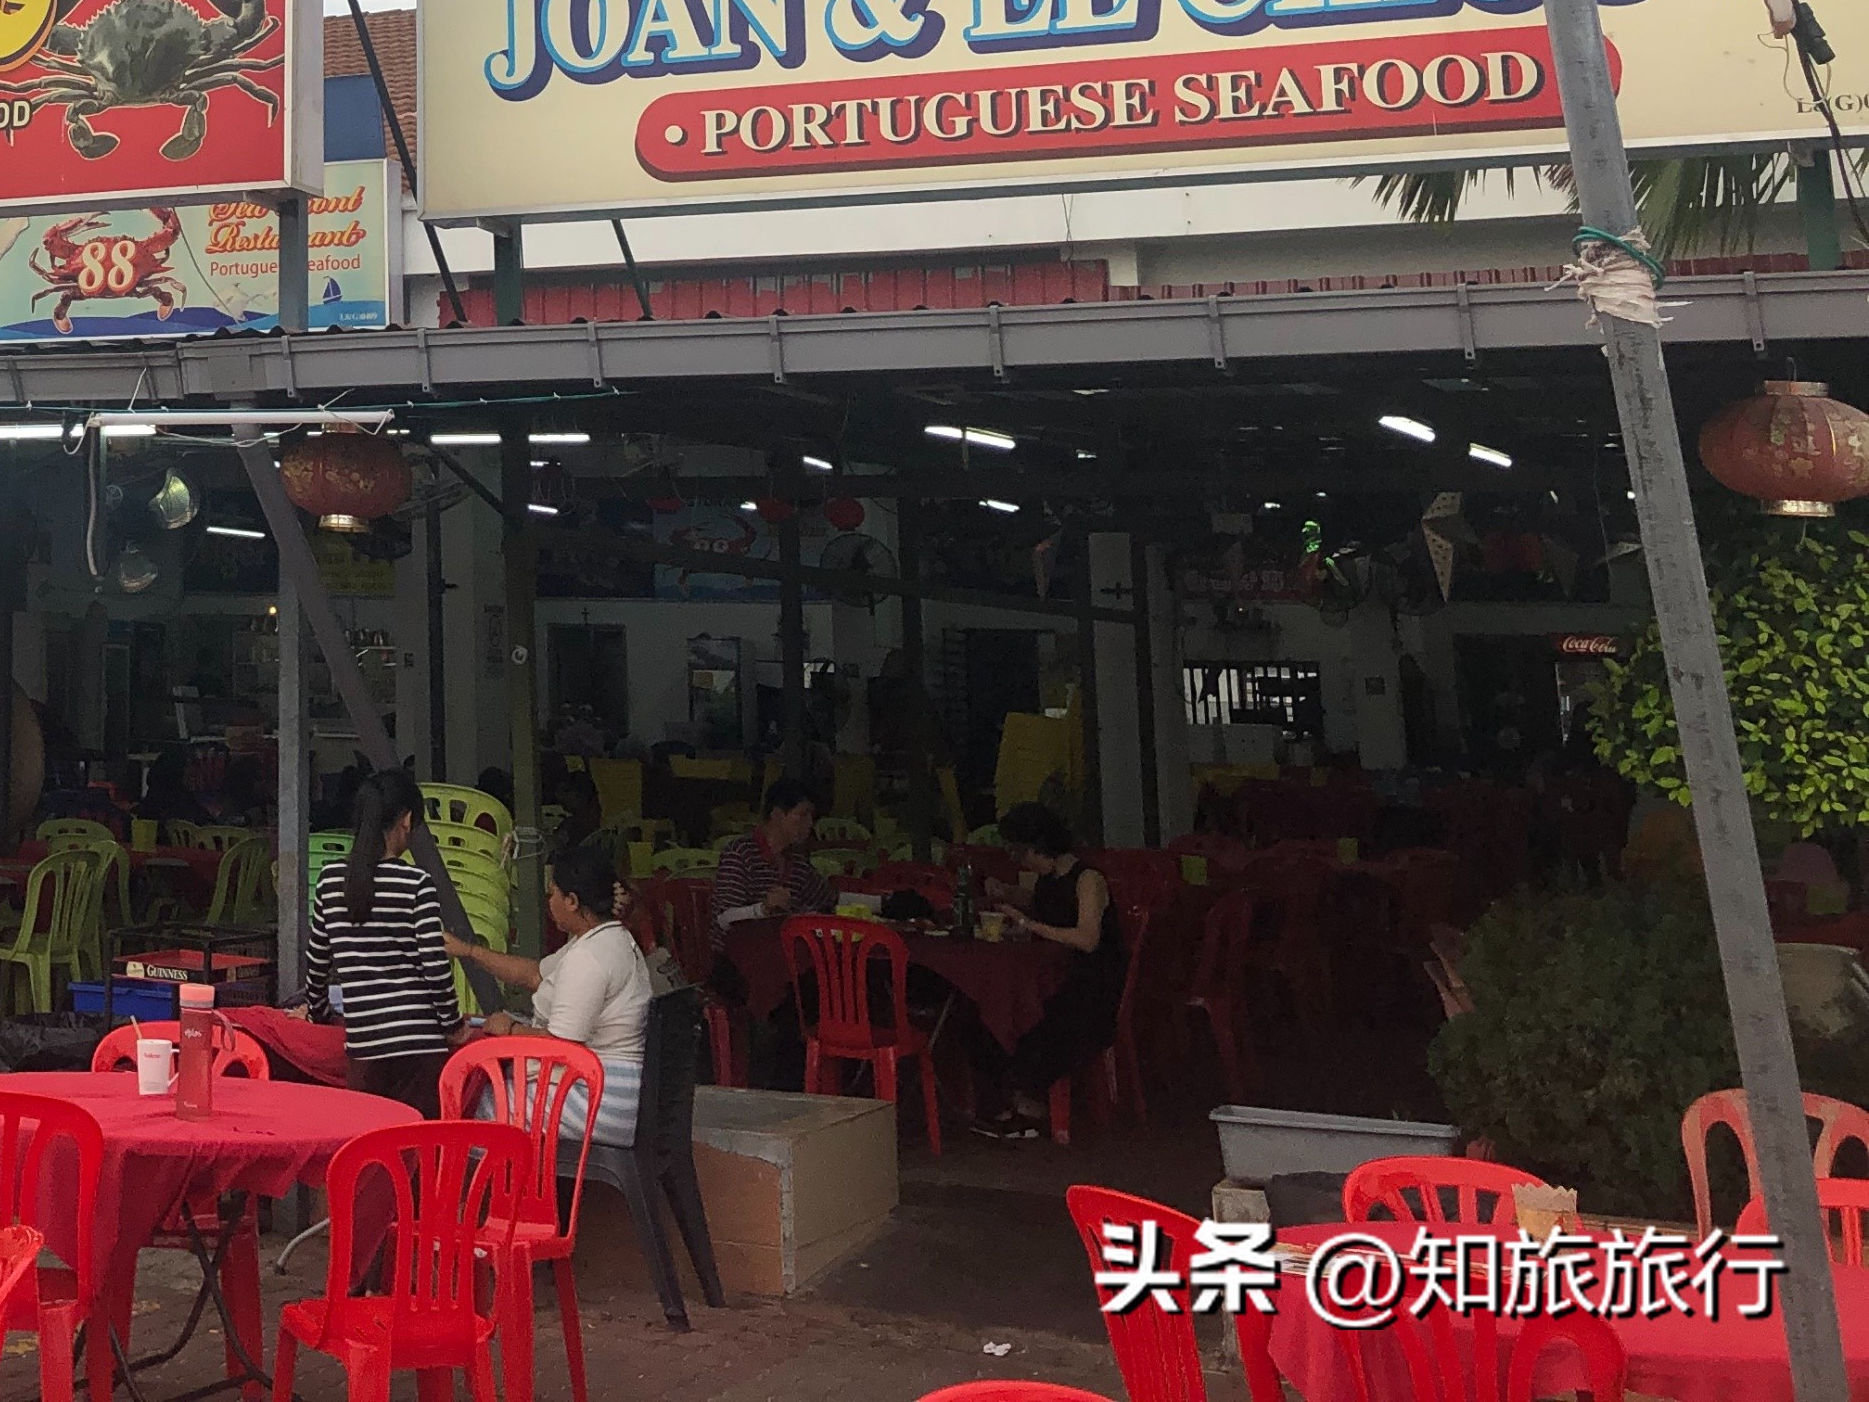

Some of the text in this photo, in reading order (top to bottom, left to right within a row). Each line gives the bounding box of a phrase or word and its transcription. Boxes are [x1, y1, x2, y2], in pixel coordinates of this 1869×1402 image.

[699, 50, 1546, 157] PORTUGUESE SEAFOOD
[78, 240, 136, 294] 88
[210, 254, 361, 279] Portugue eafood
[147, 964, 188, 980] GUINNESS
